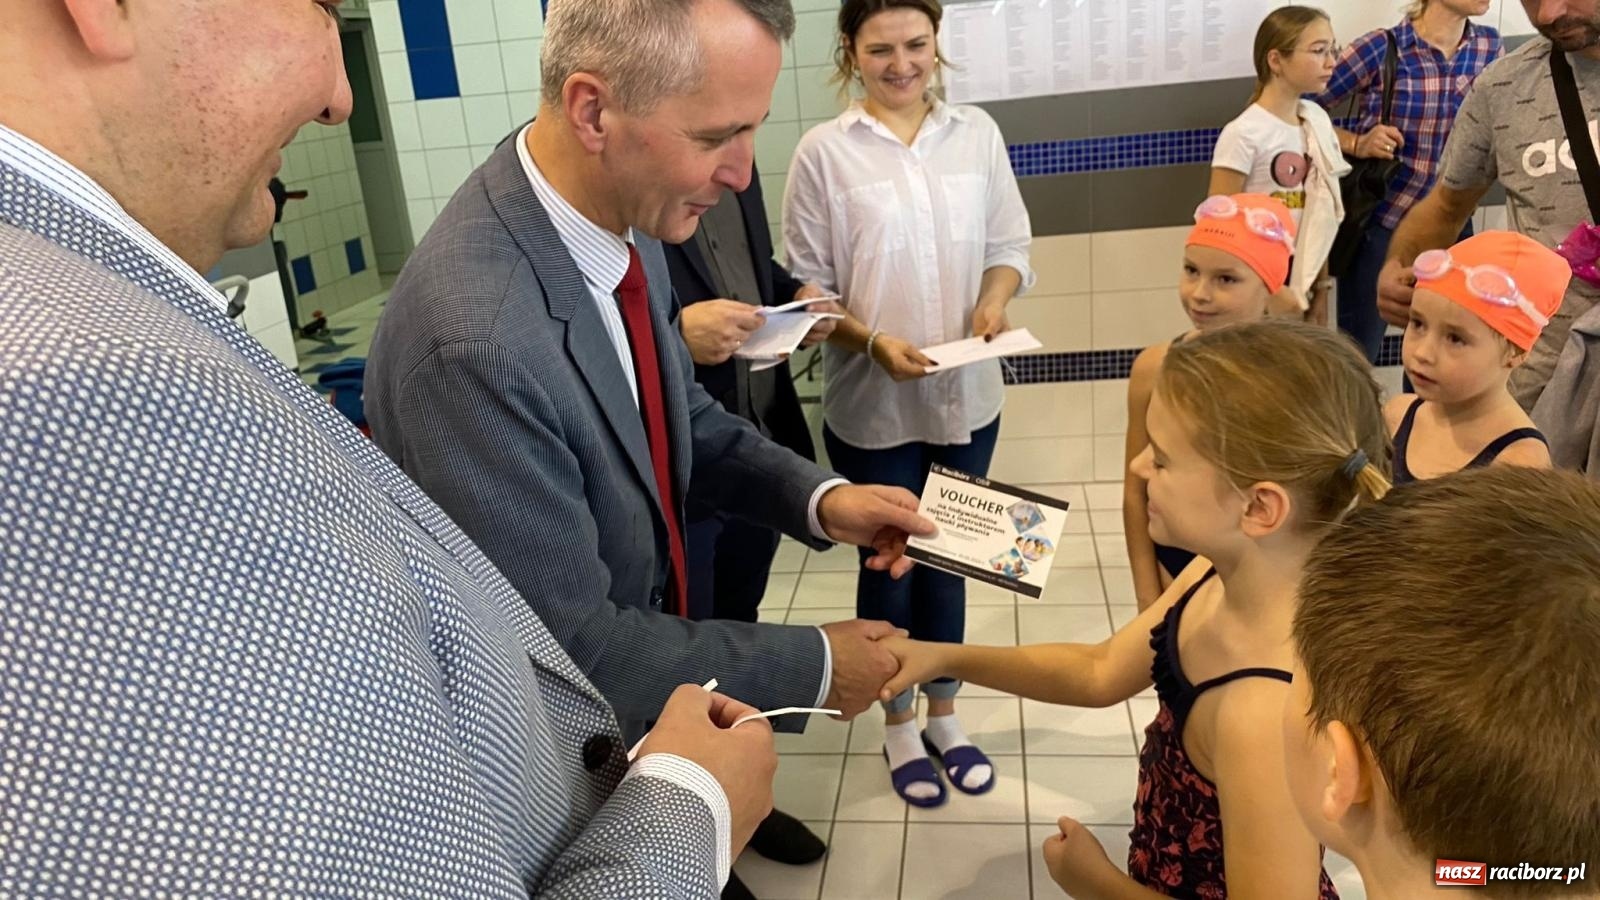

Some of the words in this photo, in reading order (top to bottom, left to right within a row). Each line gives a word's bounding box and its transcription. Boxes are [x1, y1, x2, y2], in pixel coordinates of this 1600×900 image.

[940, 487, 1004, 516] VOUCHER
[948, 505, 997, 525] indywidualne
[957, 515, 1005, 534] instruktorem
[935, 516, 955, 526] nauki
[956, 522, 990, 537] pływania
